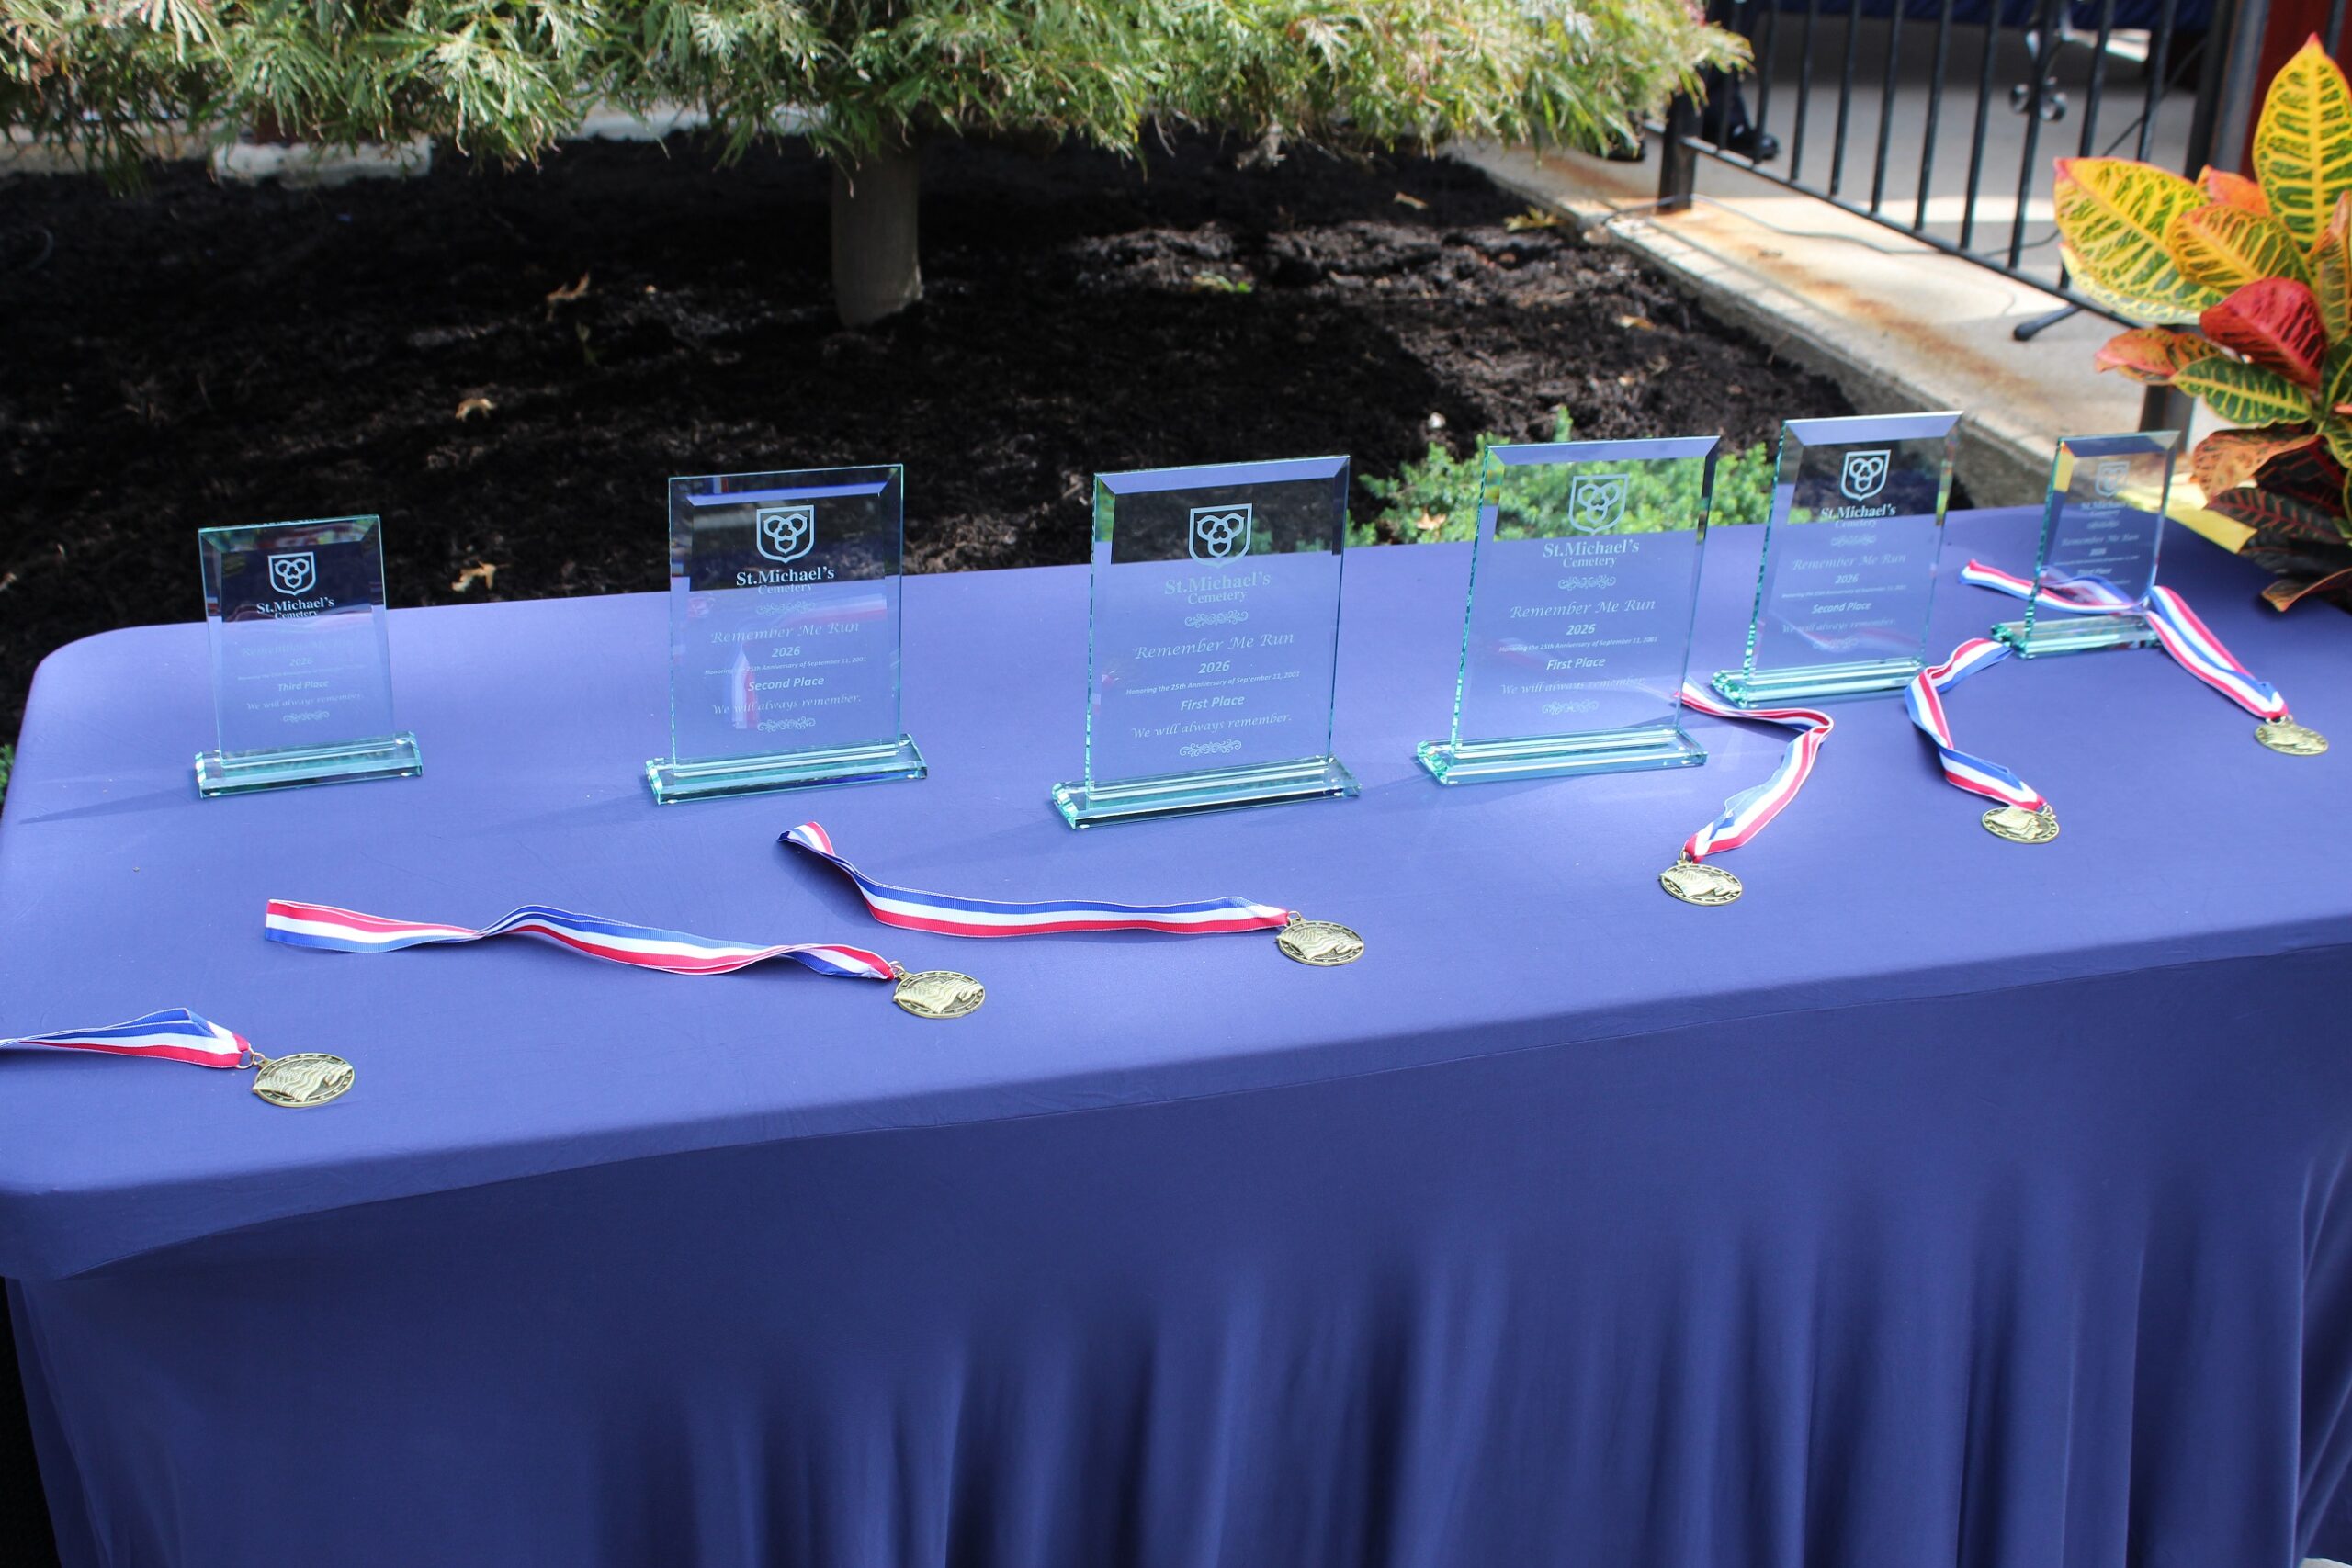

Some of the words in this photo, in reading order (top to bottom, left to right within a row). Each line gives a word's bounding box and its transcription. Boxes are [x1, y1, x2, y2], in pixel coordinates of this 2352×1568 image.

[1820, 503, 1897, 520] St.Michael's
[1544, 538, 1640, 558] St.Michael's
[1563, 557, 1617, 569] Cemetery
[736, 566, 835, 586] St.Michael's
[1164, 571, 1272, 595] St.Michael's
[1835, 573, 1860, 584] 2026
[757, 583, 812, 595] Cemetery
[1188, 590, 1248, 604] Cemetery
[256, 597, 335, 614] St.Michael's
[1510, 601, 1592, 619] Remember
[1594, 600, 1620, 613] Me
[1624, 599, 1657, 612] Run
[1812, 603, 1846, 615] Second
[1847, 602, 1872, 612] Place
[710, 626, 794, 644] Remember
[799, 624, 822, 636] Me
[1566, 623, 1596, 636] 2026
[771, 646, 801, 658] 2026
[1132, 637, 1225, 660] Remember
[1227, 636, 1254, 649] Me
[1260, 634, 1294, 647] Run
[1197, 660, 1231, 674] 2026
[1546, 659, 1573, 671] First
[1574, 657, 1607, 669] Place
[278, 682, 302, 691] Third
[304, 680, 329, 689] Place
[748, 678, 790, 692] Second
[793, 676, 825, 688] Place
[1125, 685, 1158, 696] Honoring
[1170, 682, 1186, 691] 25th
[1187, 679, 1227, 689] Anniversary
[1236, 674, 1272, 685] September
[1499, 683, 1518, 695] We
[1521, 681, 1546, 694] will
[712, 704, 730, 715] We
[758, 699, 797, 712] always
[1181, 698, 1208, 711] First
[1211, 695, 1246, 708] Place
[1130, 727, 1150, 739] We
[1155, 722, 1181, 736] will
[1181, 720, 1225, 736] always
[1227, 713, 1293, 728] remember.
